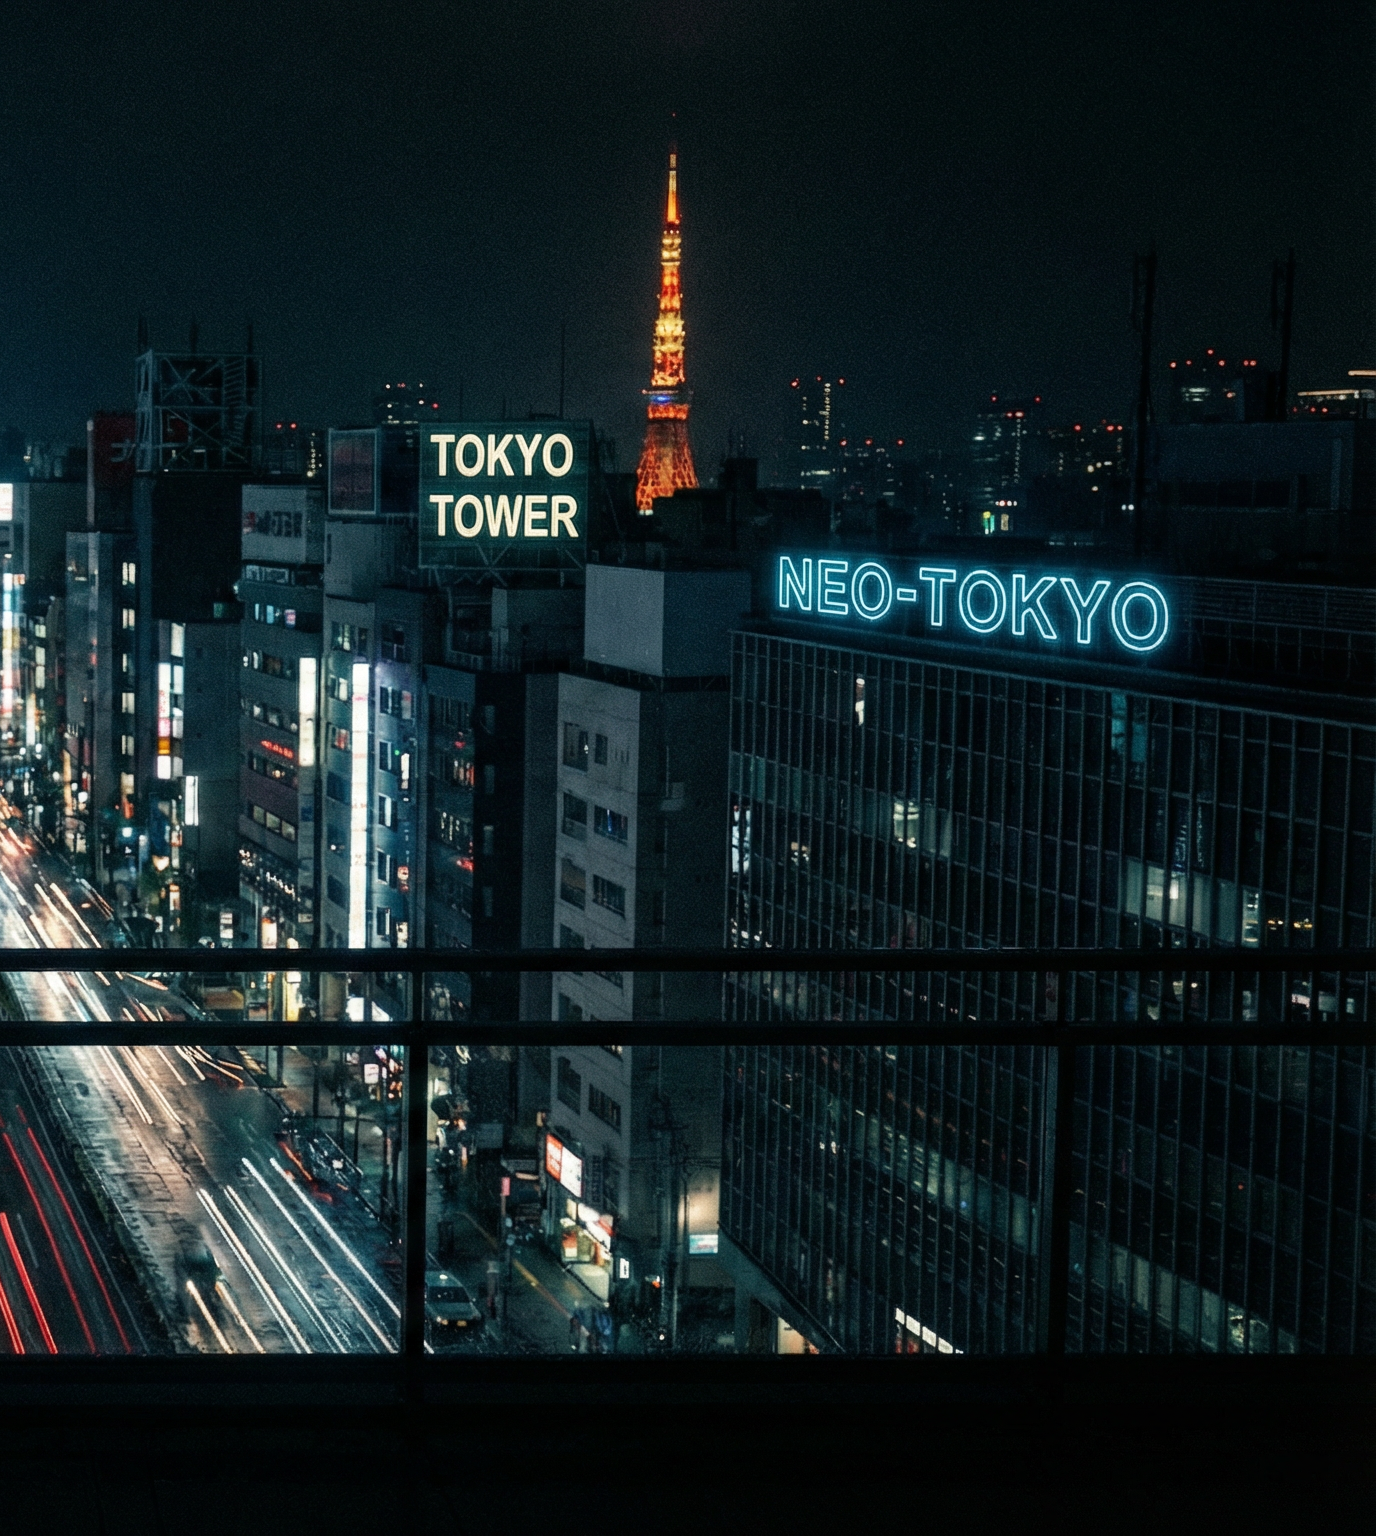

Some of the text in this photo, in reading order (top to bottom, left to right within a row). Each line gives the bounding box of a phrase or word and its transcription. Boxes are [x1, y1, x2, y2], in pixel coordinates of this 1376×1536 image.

[430, 433, 574, 477] TOKYO
[429, 494, 579, 538] TOWER
[779, 556, 1169, 651] NEO-TOKYO
